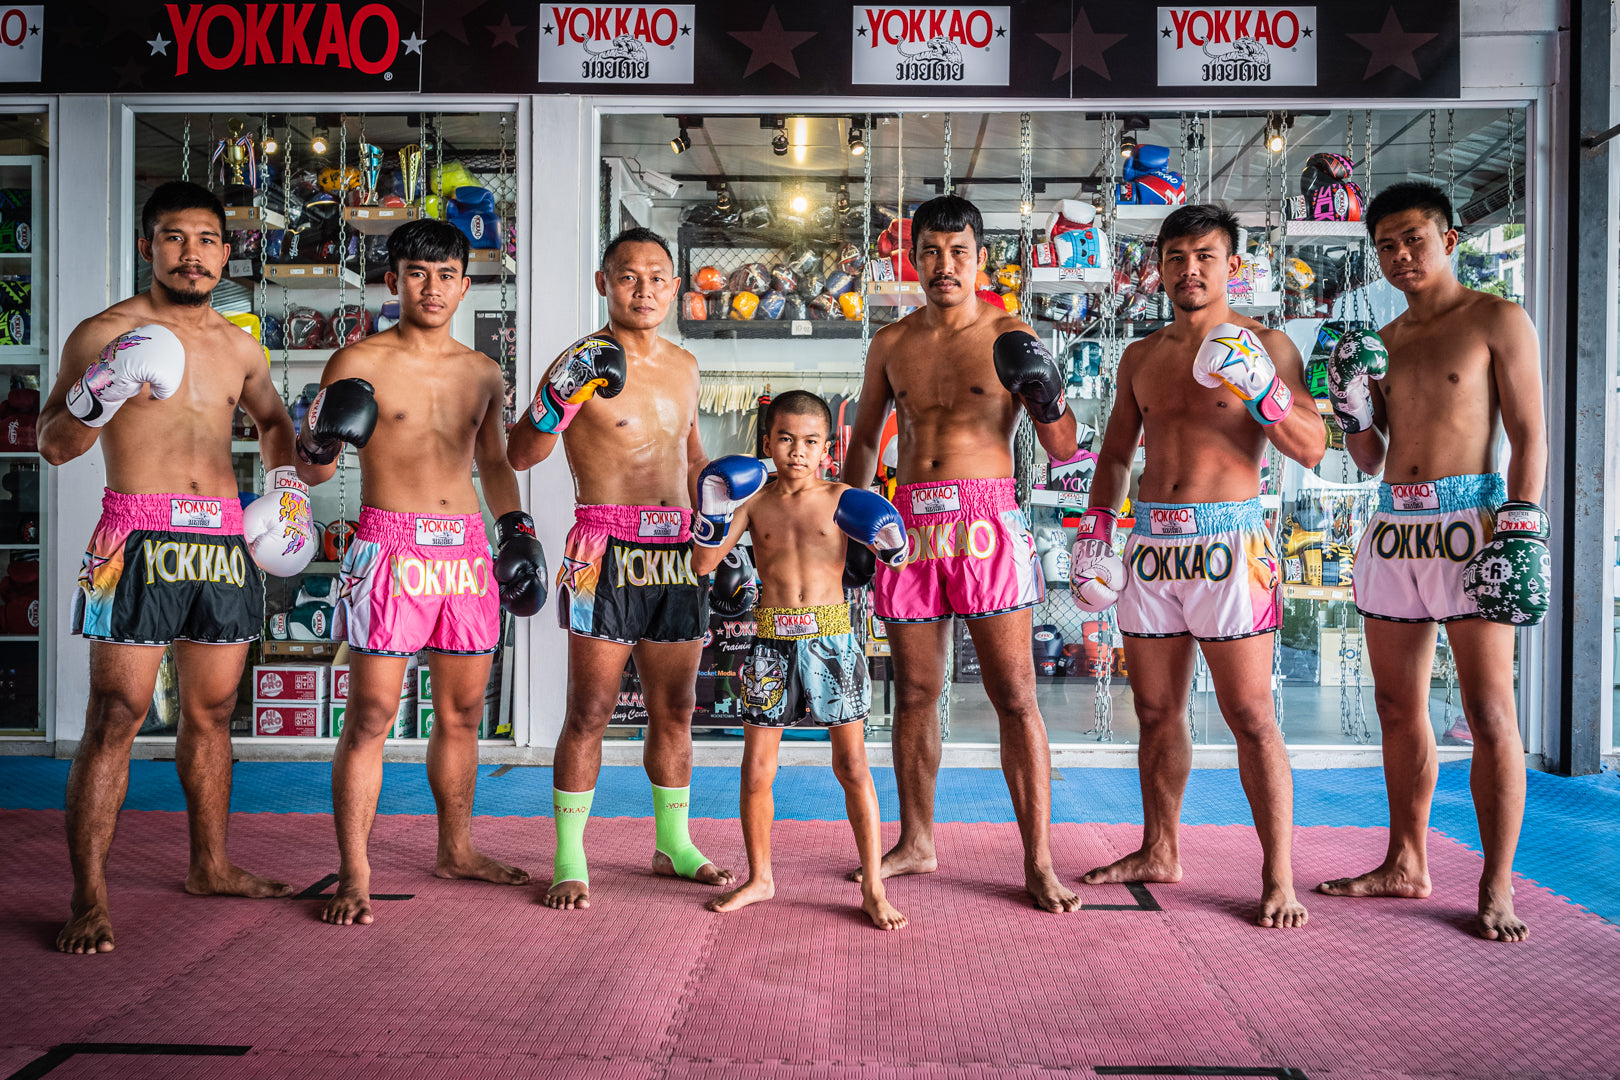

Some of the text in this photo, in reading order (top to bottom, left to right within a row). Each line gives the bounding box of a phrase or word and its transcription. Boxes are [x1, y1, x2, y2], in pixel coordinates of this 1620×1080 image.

[552, 7, 678, 46] YOKKAO
[865, 9, 993, 48] YOKKAO
[1169, 10, 1300, 49] YOKKAO
[165, 3, 400, 76] YOKKAO
[915, 486, 952, 503] YOKKAO
[1392, 484, 1430, 498] YOKKAO
[177, 500, 218, 516] YOKKAO
[1153, 509, 1189, 523] YOKKAO
[421, 519, 462, 534] YOKKAO
[646, 512, 679, 526] YOKKAO
[907, 519, 996, 564] OKKAO
[143, 539, 246, 588] YOKKAO
[389, 555, 489, 598] YOKKAO
[777, 614, 812, 627] YOKKAO
[719, 641, 751, 653] Trainin
[261, 681, 282, 690] PRO
[260, 717, 281, 727] PRO
